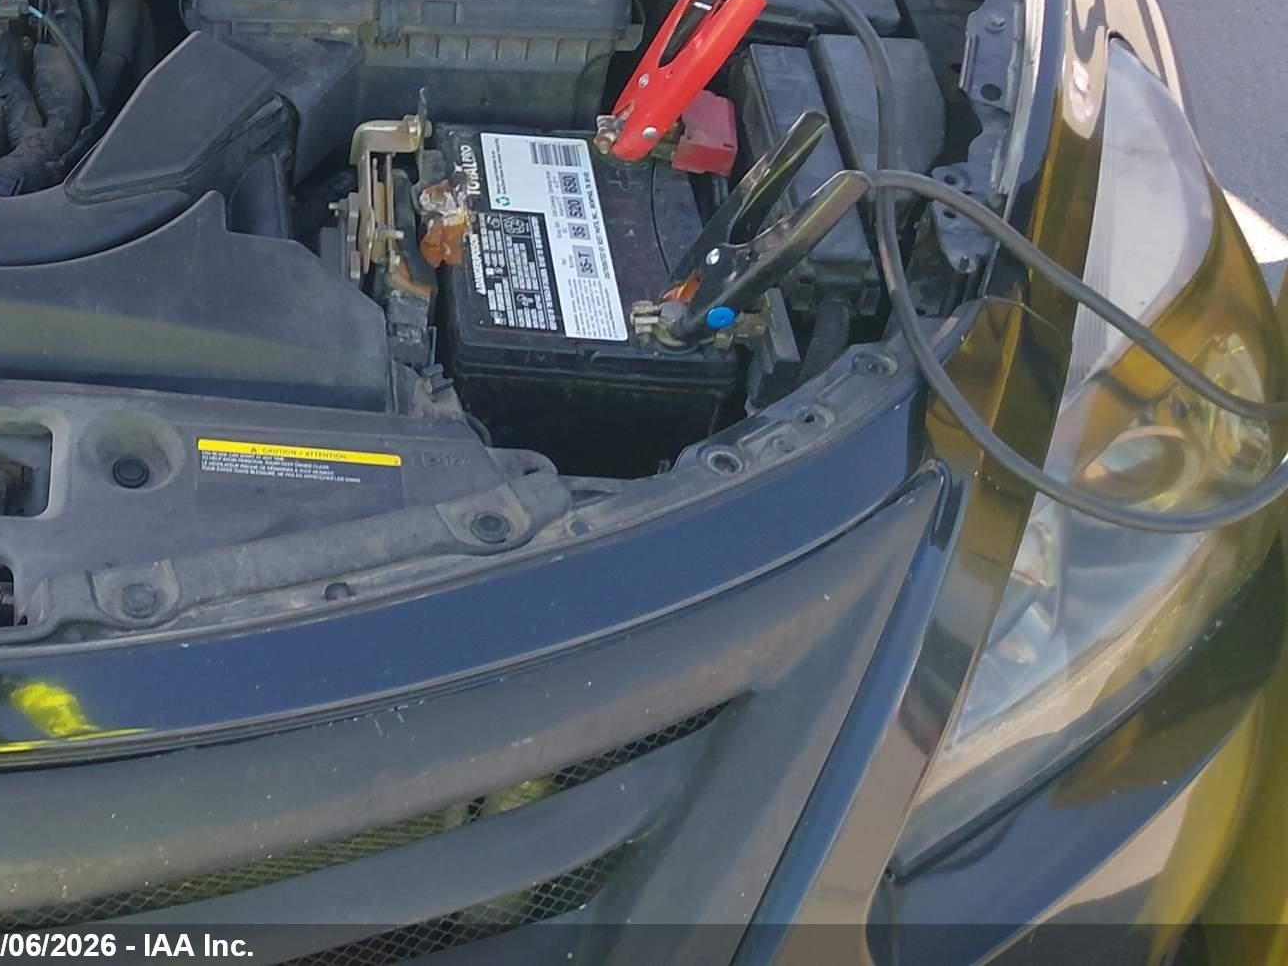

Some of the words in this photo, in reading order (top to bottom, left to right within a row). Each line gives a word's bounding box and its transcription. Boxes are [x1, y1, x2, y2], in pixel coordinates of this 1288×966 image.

[562, 174, 579, 193] 650
[566, 199, 583, 219] 520
[262, 447, 297, 455] CAUTION
[304, 449, 348, 459] ATTENTION
